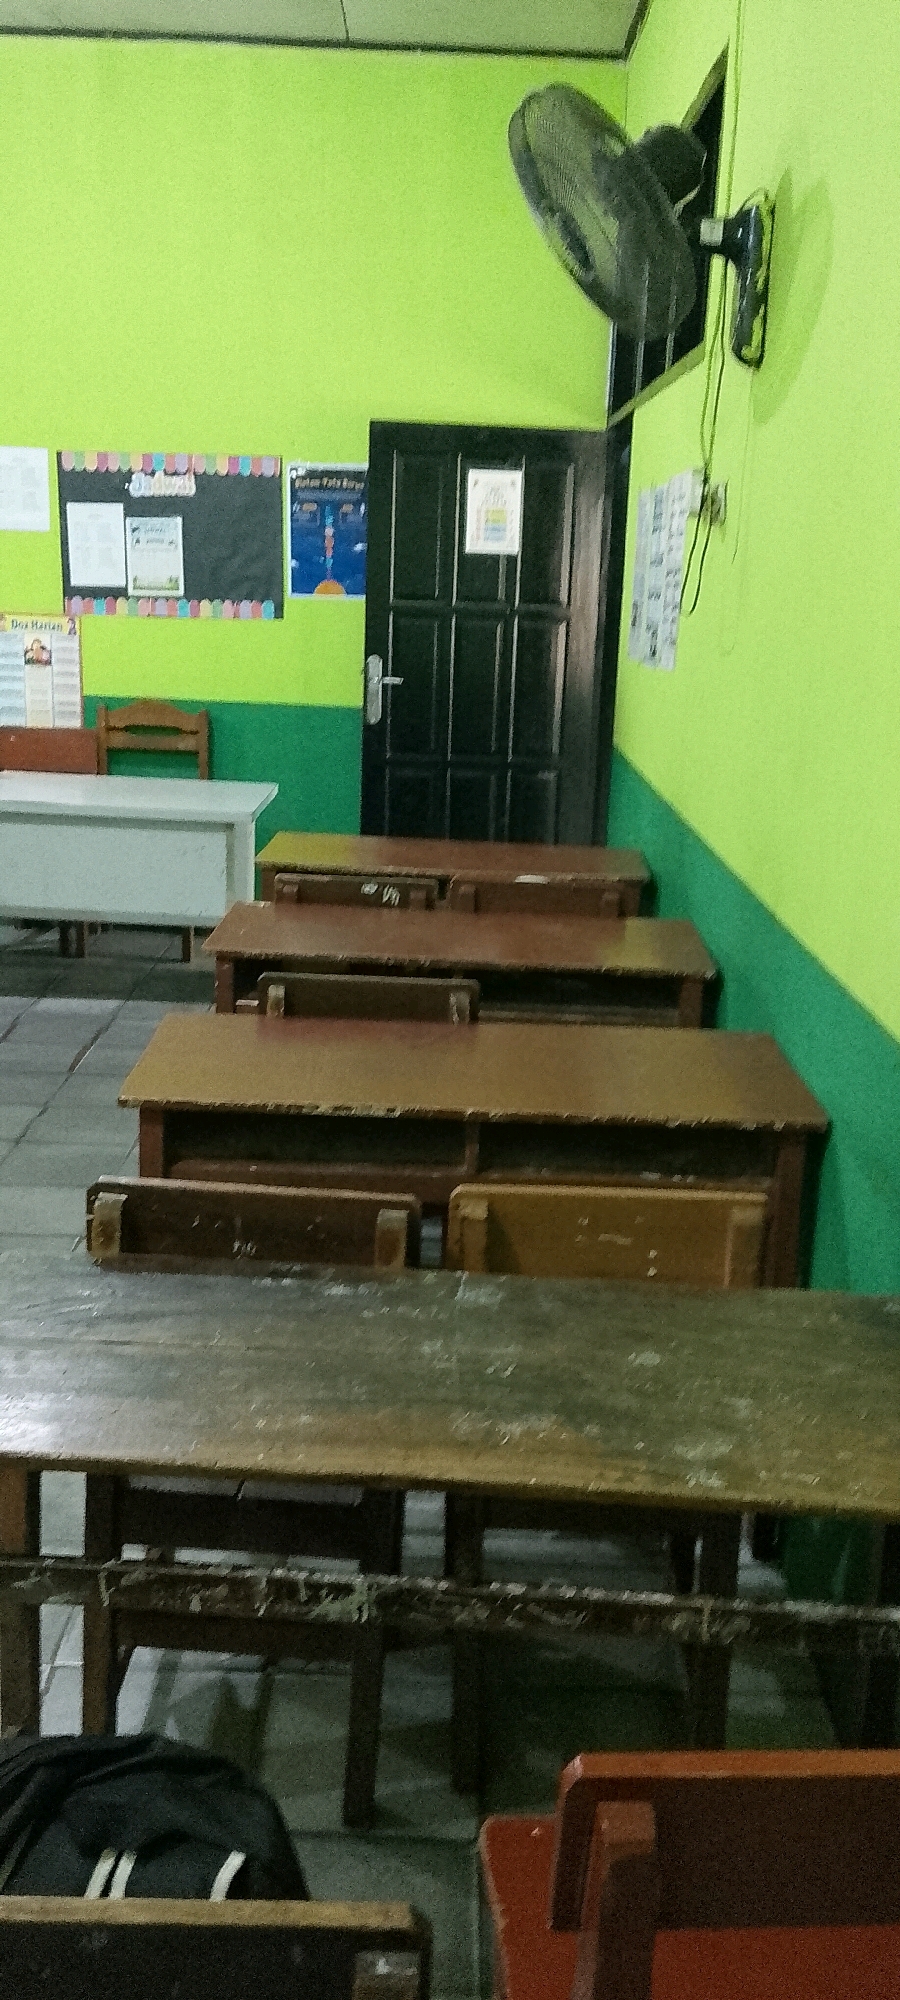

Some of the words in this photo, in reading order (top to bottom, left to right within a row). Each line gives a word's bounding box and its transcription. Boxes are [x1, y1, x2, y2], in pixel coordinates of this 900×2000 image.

[130, 472, 195, 497] Jadwal
[11, 619, 29, 630] Doa
[31, 620, 63, 632] Harian
